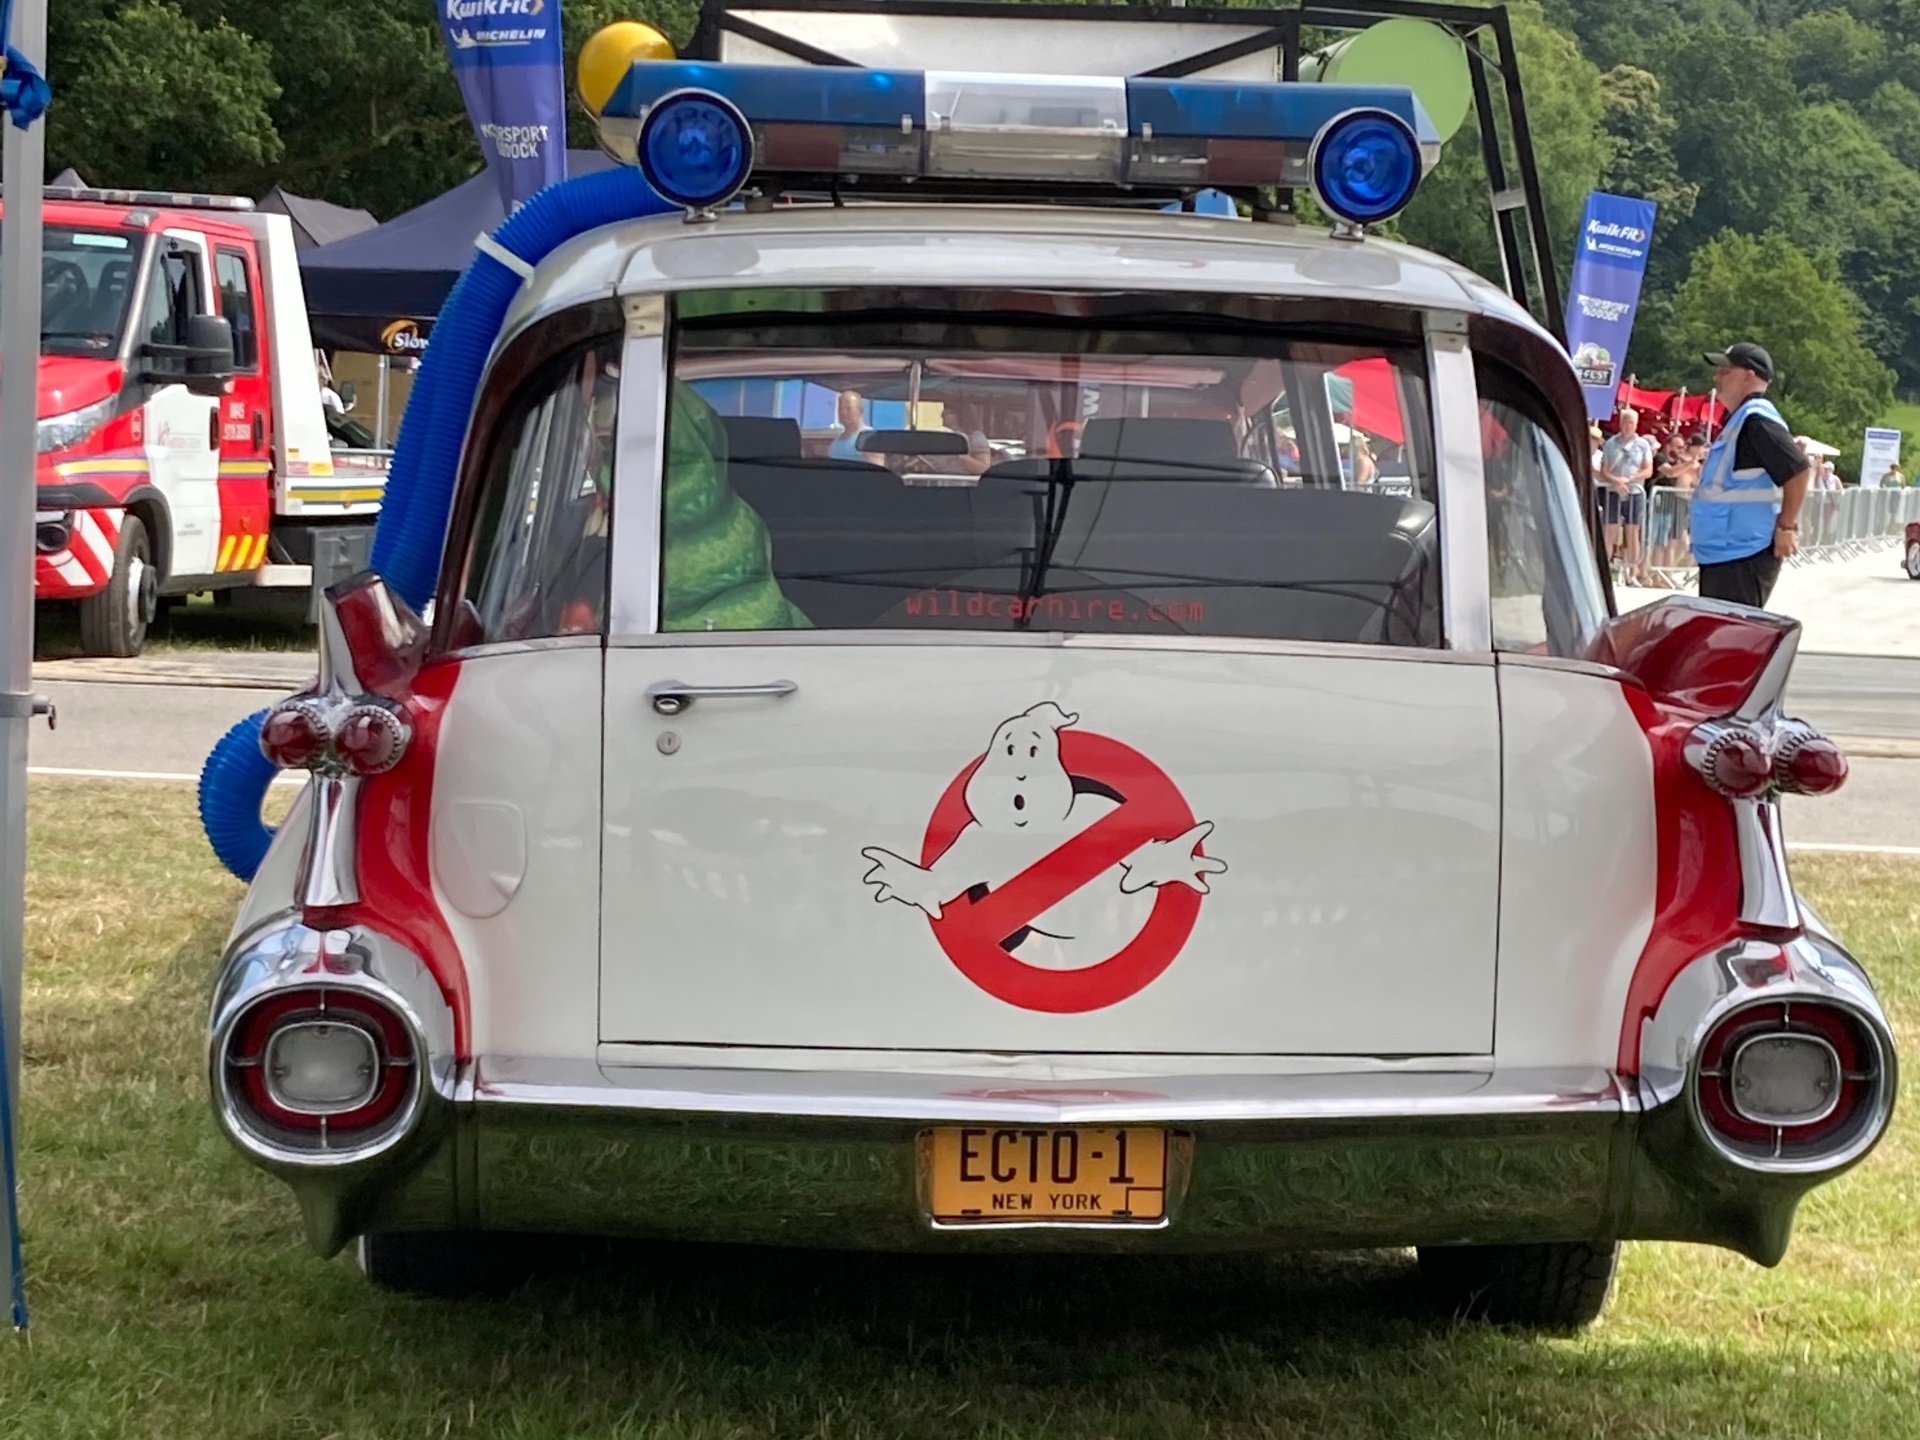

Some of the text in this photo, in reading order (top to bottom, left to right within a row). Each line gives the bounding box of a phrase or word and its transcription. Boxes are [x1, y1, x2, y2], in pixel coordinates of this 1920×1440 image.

[905, 587, 1205, 622] wildcarhire.com
[959, 1129, 1134, 1184] ECTO-1
[992, 1193, 1102, 1210] NEW YORK
